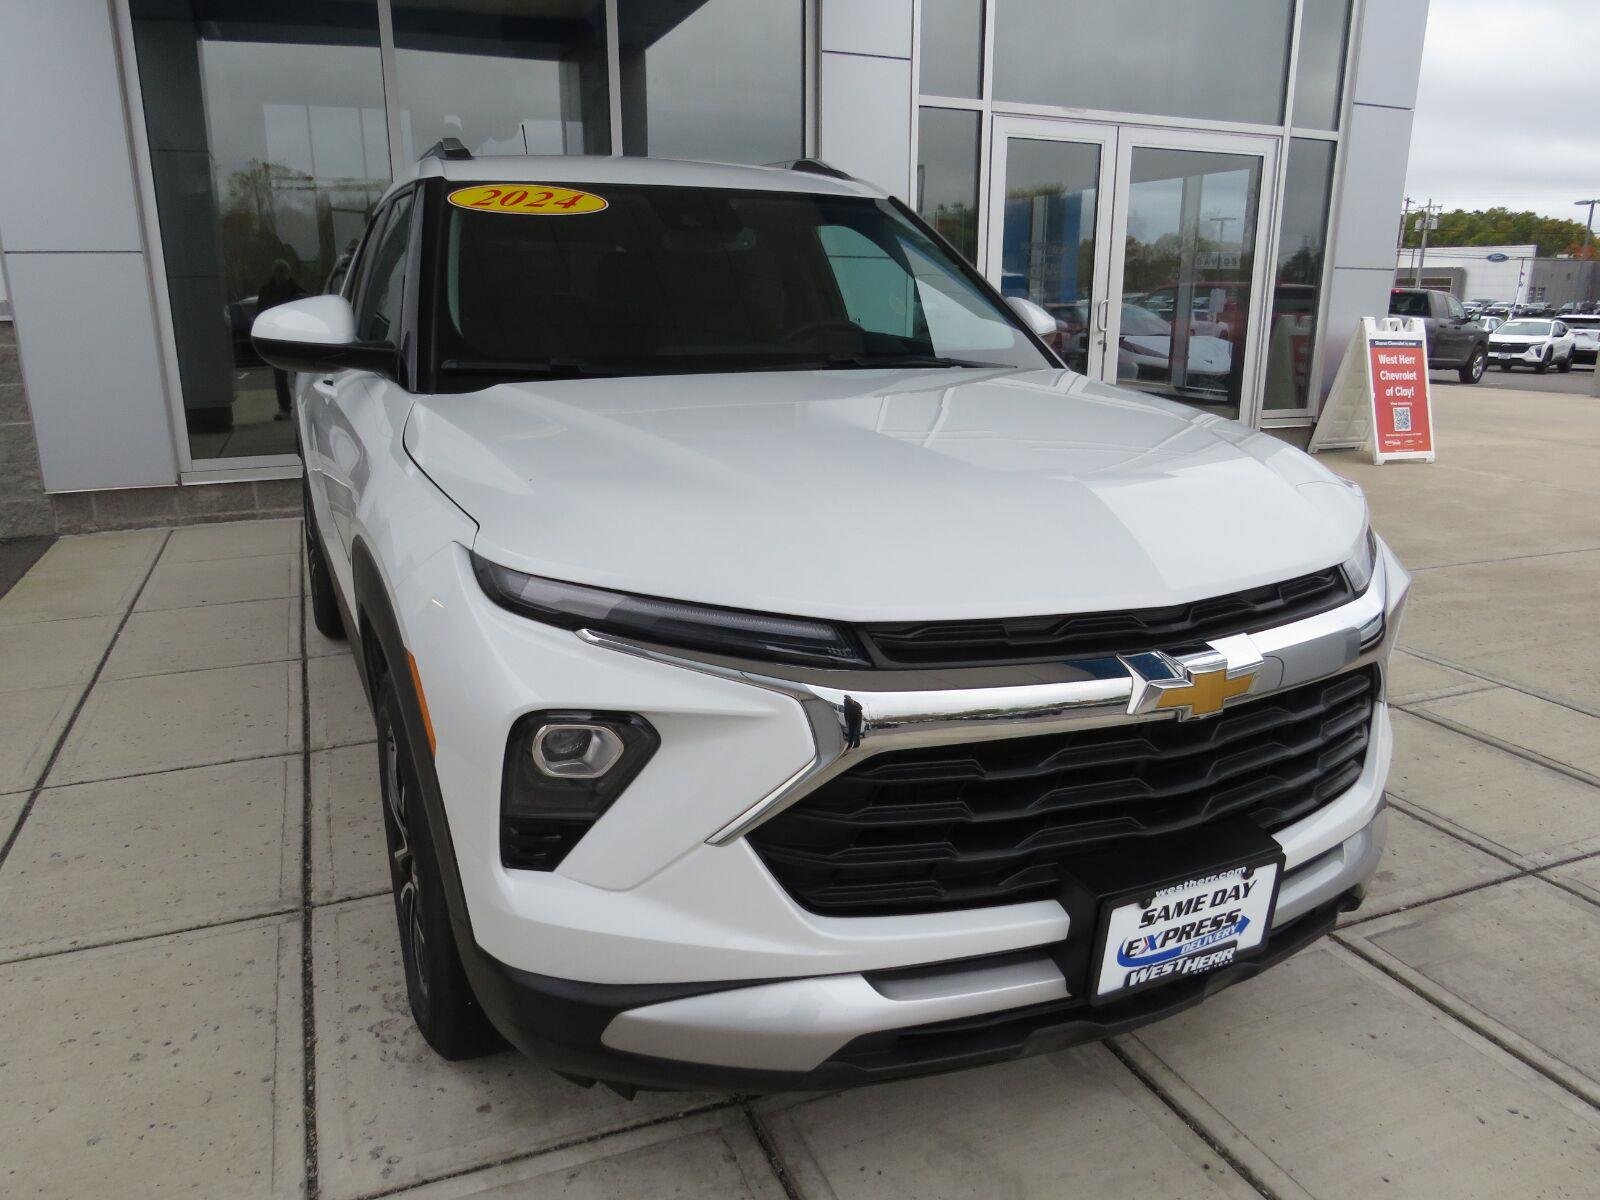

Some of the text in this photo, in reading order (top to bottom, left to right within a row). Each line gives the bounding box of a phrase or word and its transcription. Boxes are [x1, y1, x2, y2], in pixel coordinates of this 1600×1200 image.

[470, 189, 585, 209] 2024
[1378, 354, 1416, 365] West Herr
[1380, 370, 1417, 381] Chevrolet
[1385, 386, 1415, 398] of Clay!
[1155, 866, 1247, 897] westherr.com
[1139, 880, 1257, 928] SAME DAY
[1124, 908, 1241, 958] EXPRESS
[1181, 924, 1239, 954] DELIVERY
